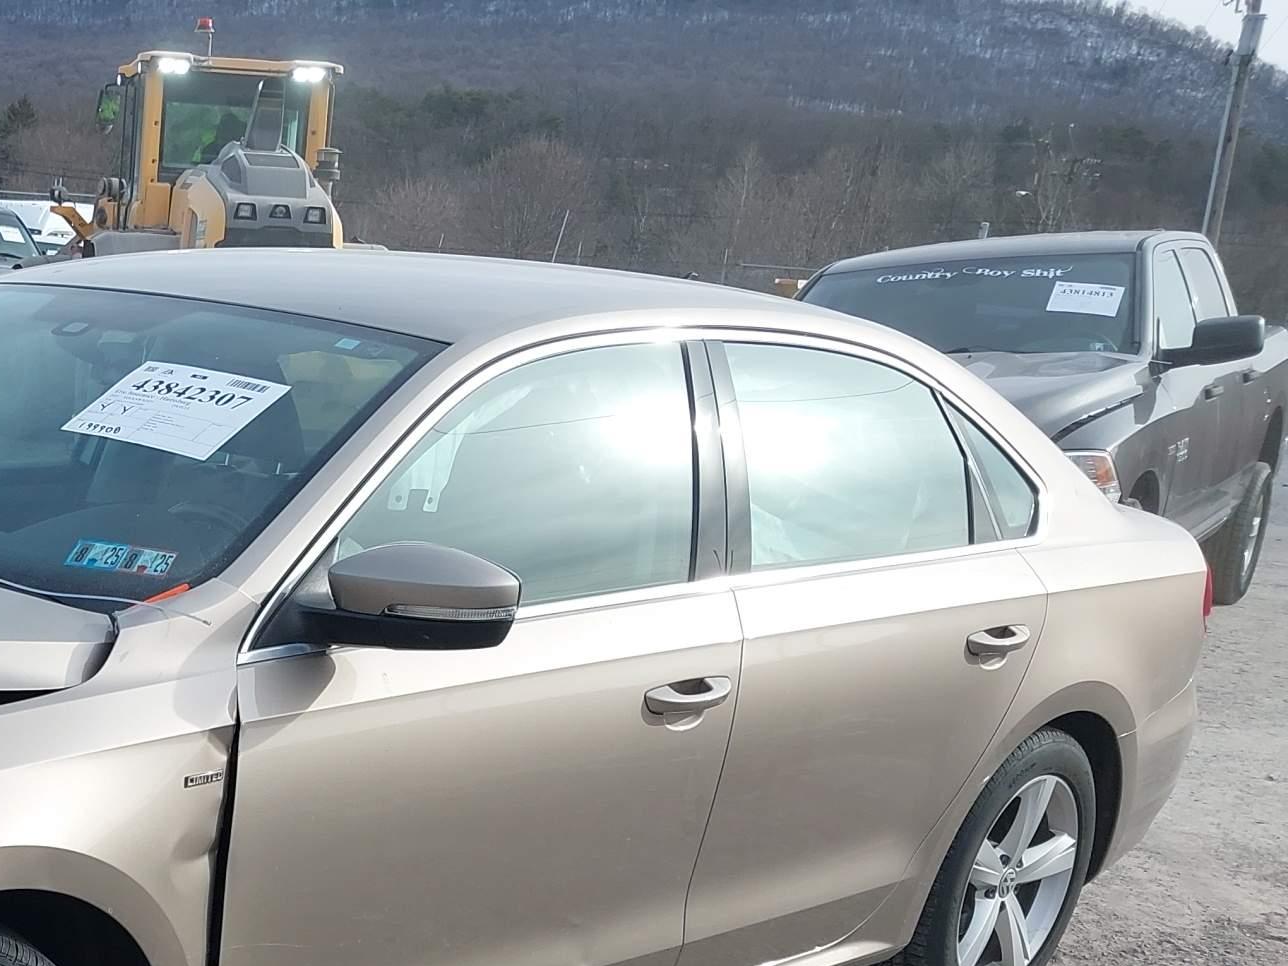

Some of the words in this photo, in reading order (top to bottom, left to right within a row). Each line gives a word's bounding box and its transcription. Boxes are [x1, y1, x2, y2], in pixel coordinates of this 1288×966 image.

[876, 268, 958, 284] Country
[1020, 266, 1073, 279] Shit
[131, 378, 254, 410] 43842307
[103, 547, 125, 566] 25
[153, 554, 174, 574] 25
